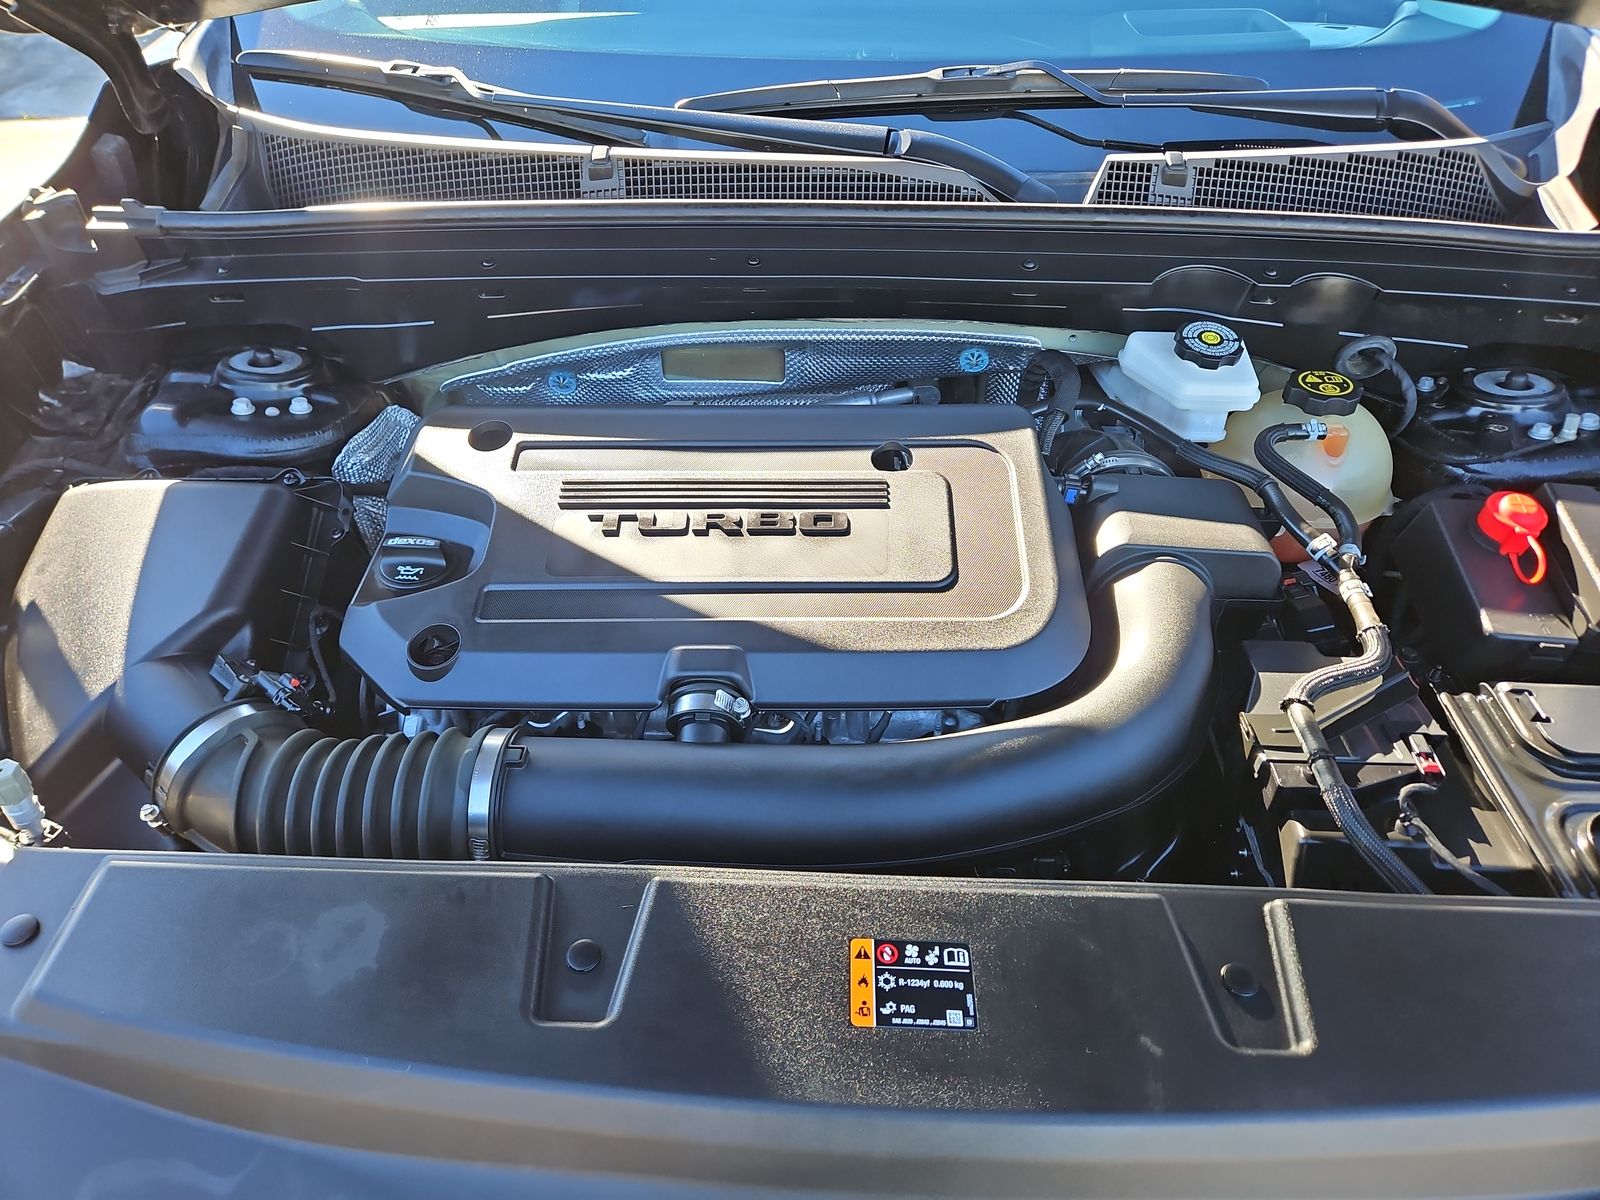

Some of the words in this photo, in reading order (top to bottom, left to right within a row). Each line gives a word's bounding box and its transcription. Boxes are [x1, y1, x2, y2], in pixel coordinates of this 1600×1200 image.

[588, 512, 851, 537] TURBO
[387, 536, 437, 546] dexos
[904, 957, 921, 965] AUTO
[898, 978, 931, 989] R-1234yf
[933, 979, 954, 989] 0.600
[954, 981, 964, 991] kg
[900, 1004, 916, 1014] PAG
